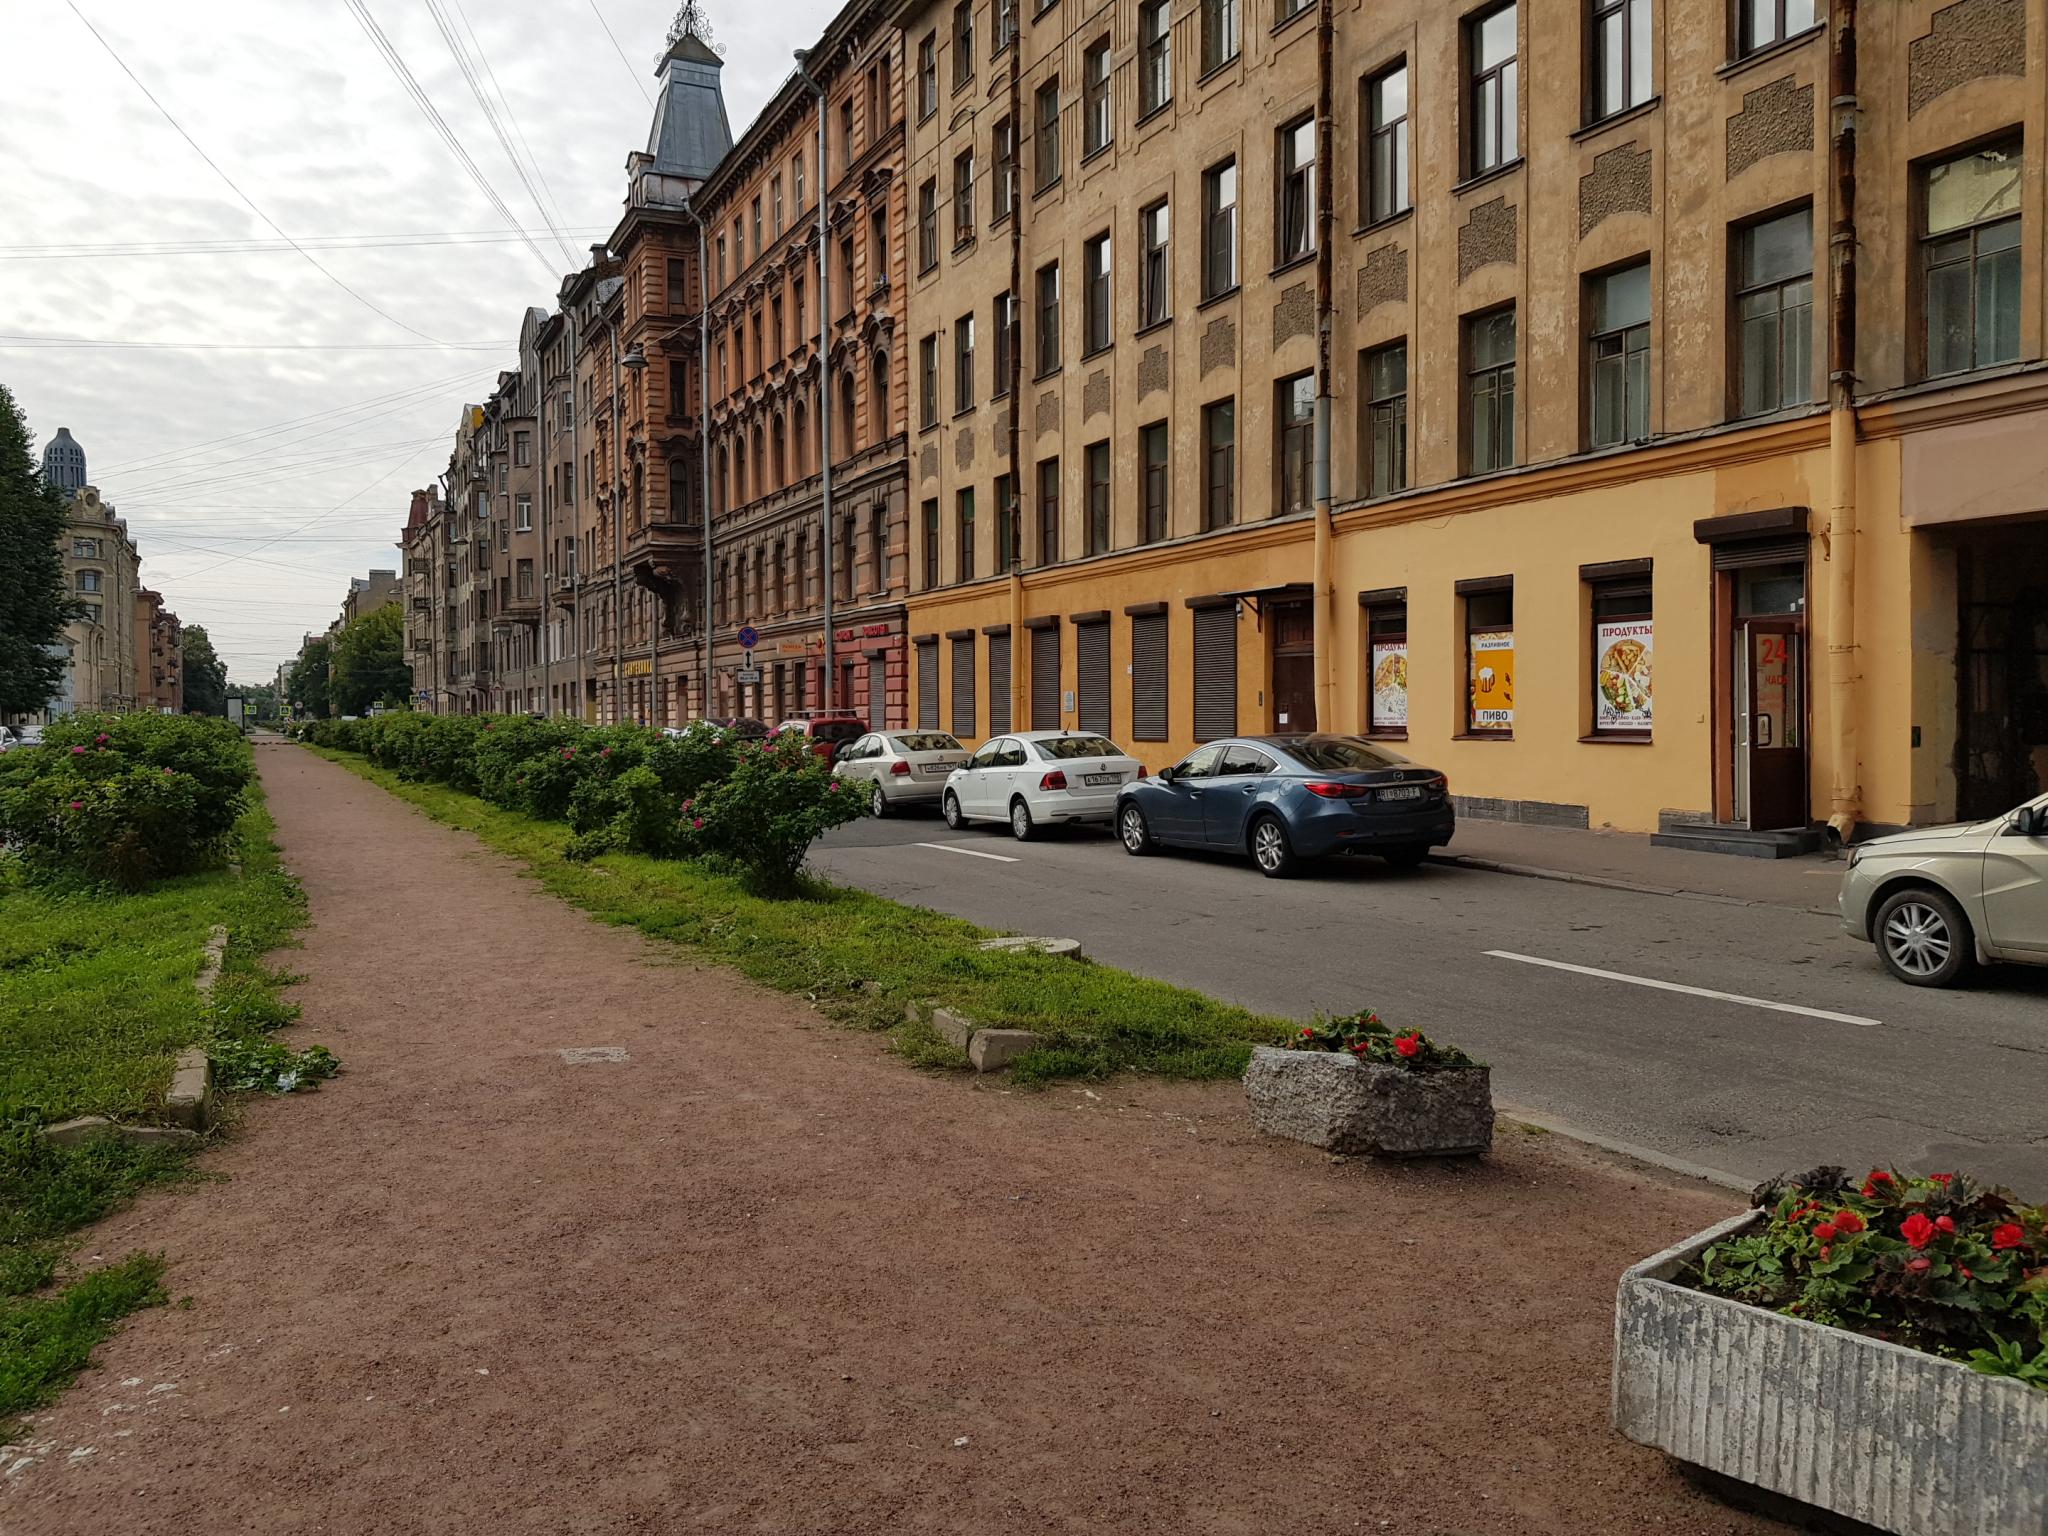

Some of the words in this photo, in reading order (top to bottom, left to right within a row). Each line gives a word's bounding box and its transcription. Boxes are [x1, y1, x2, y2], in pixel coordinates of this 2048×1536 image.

[1602, 625, 1653, 637] ПРОДУКТЫ
[1375, 643, 1408, 652] ПРОДУКТ
[1481, 641, 1510, 649] РАЗЛИВНОЕ
[1762, 639, 1789, 665] 24
[1482, 710, 1508, 721] ПИВО
